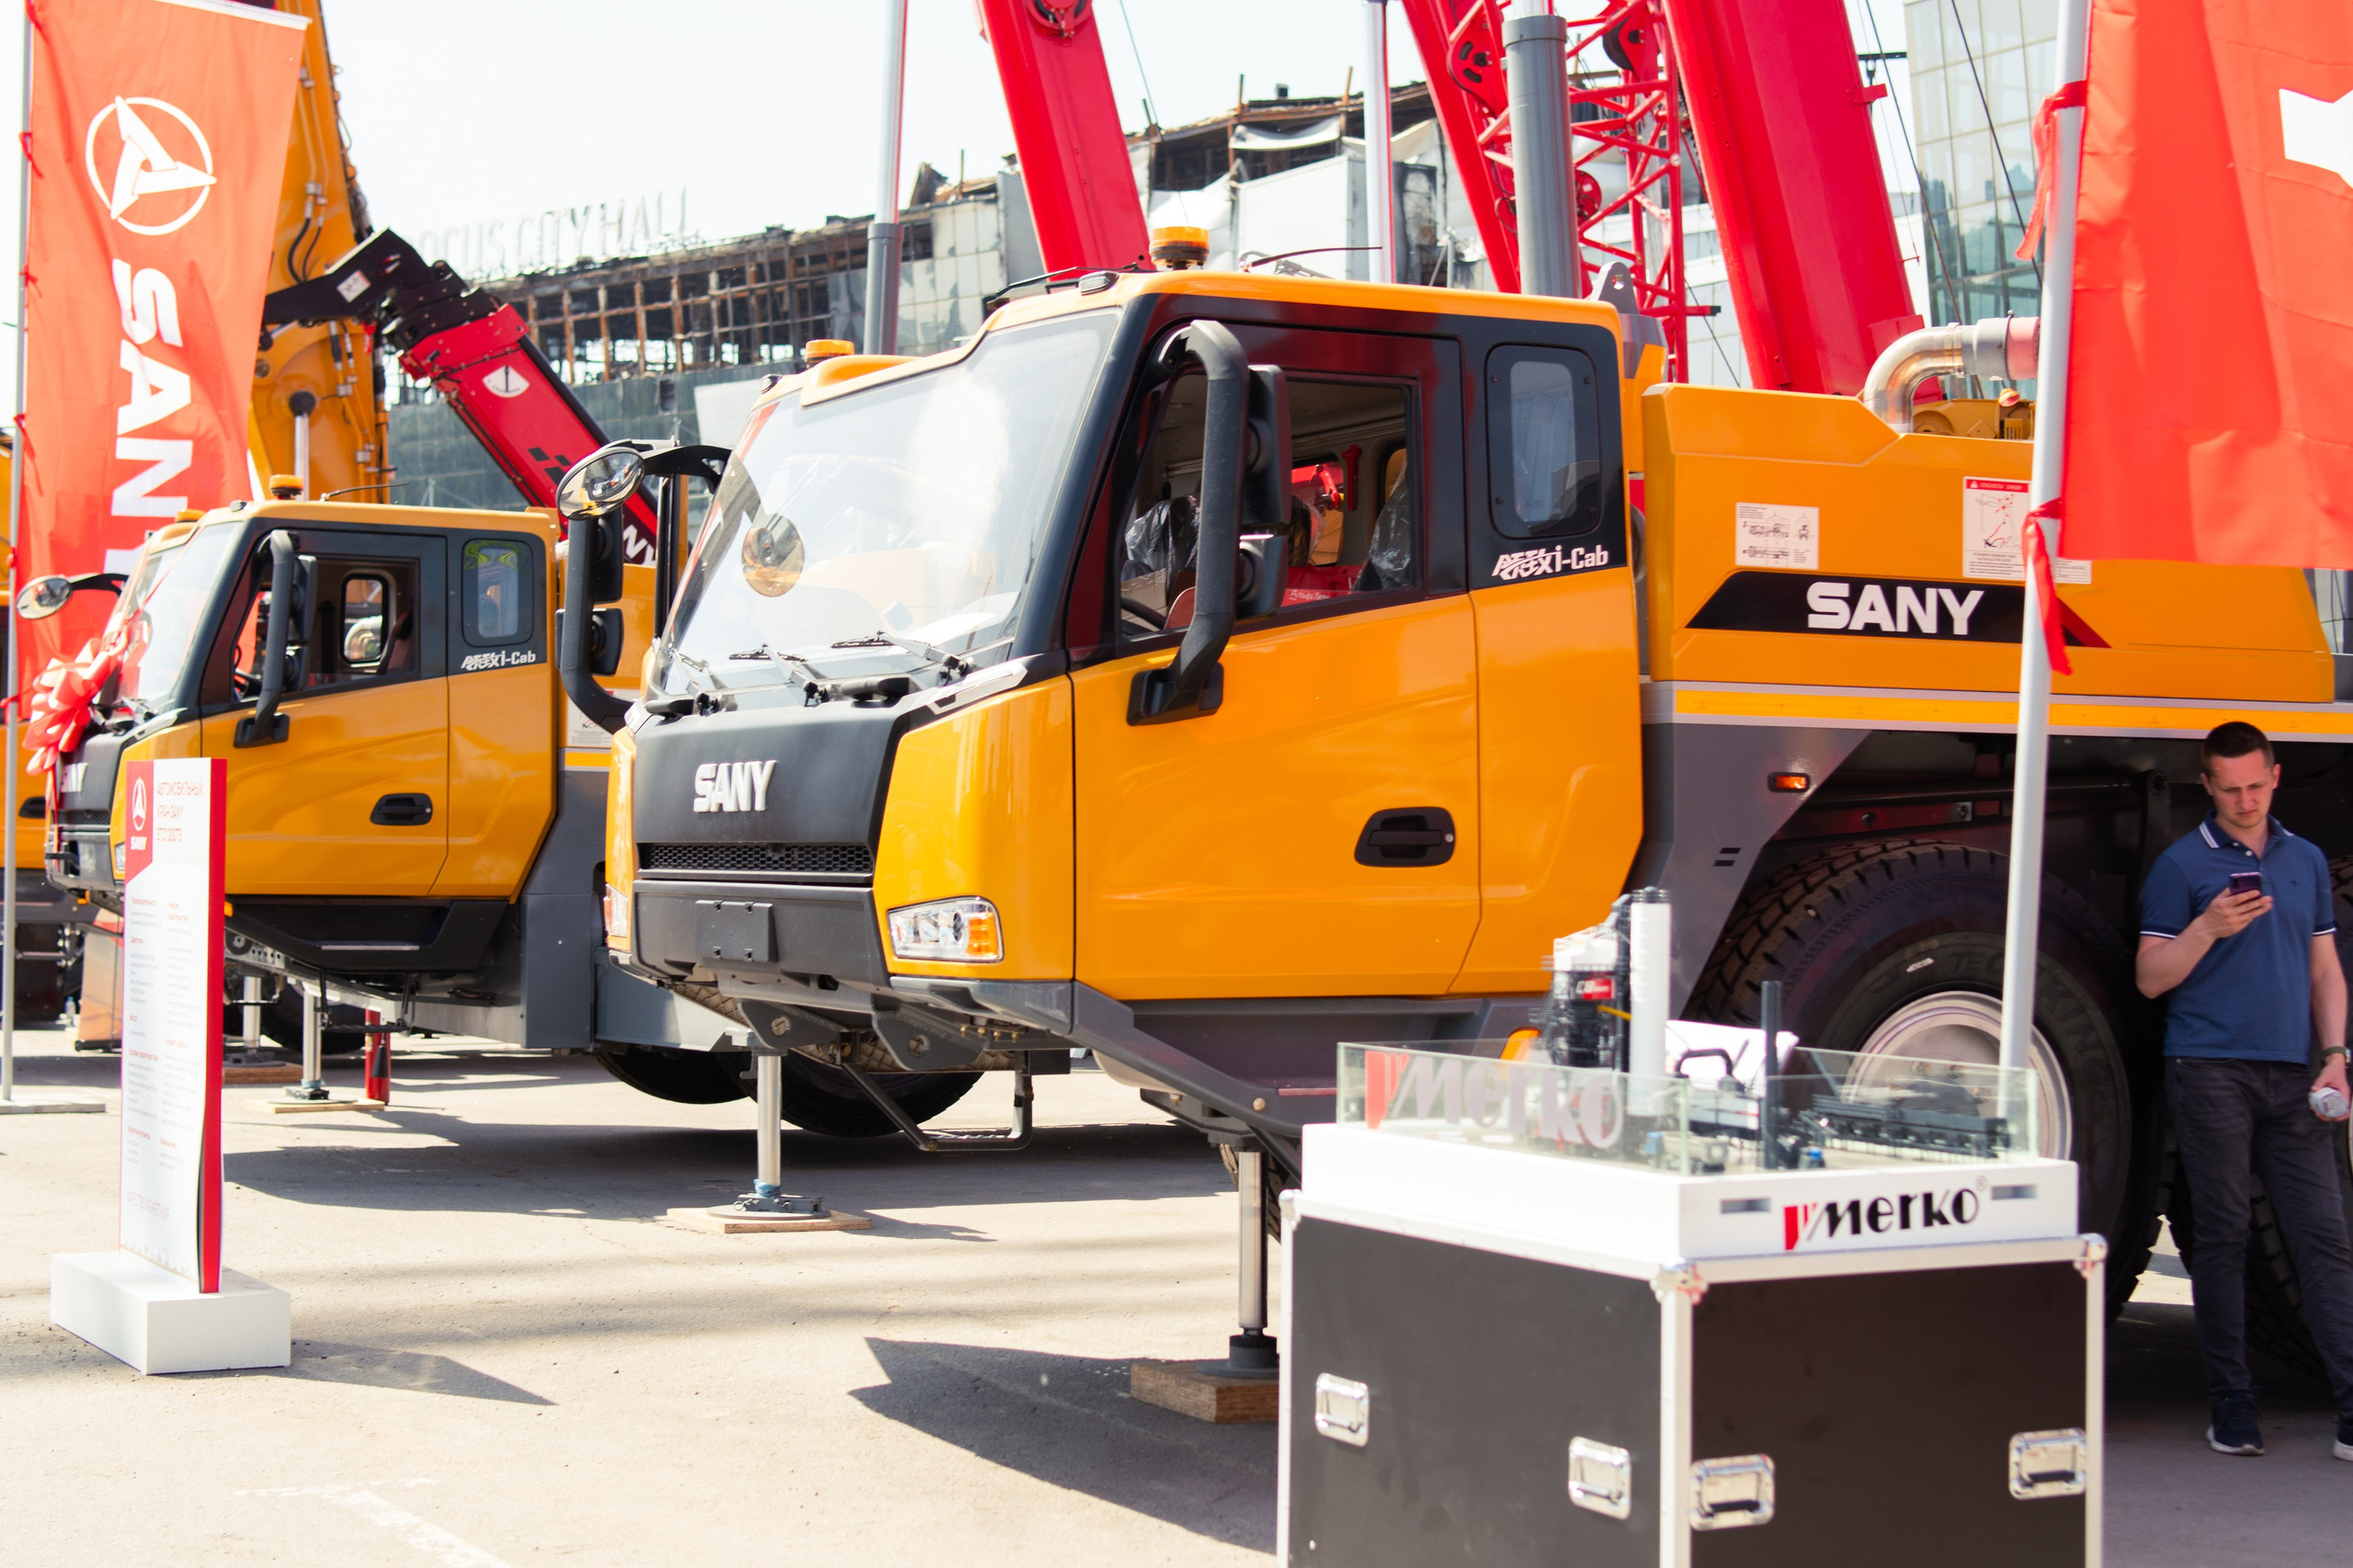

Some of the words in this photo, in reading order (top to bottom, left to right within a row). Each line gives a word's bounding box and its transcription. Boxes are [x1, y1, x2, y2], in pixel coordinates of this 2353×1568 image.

[599, 186, 699, 256] HALL
[1806, 582, 1984, 635] SANY
[693, 760, 777, 812] SANY
